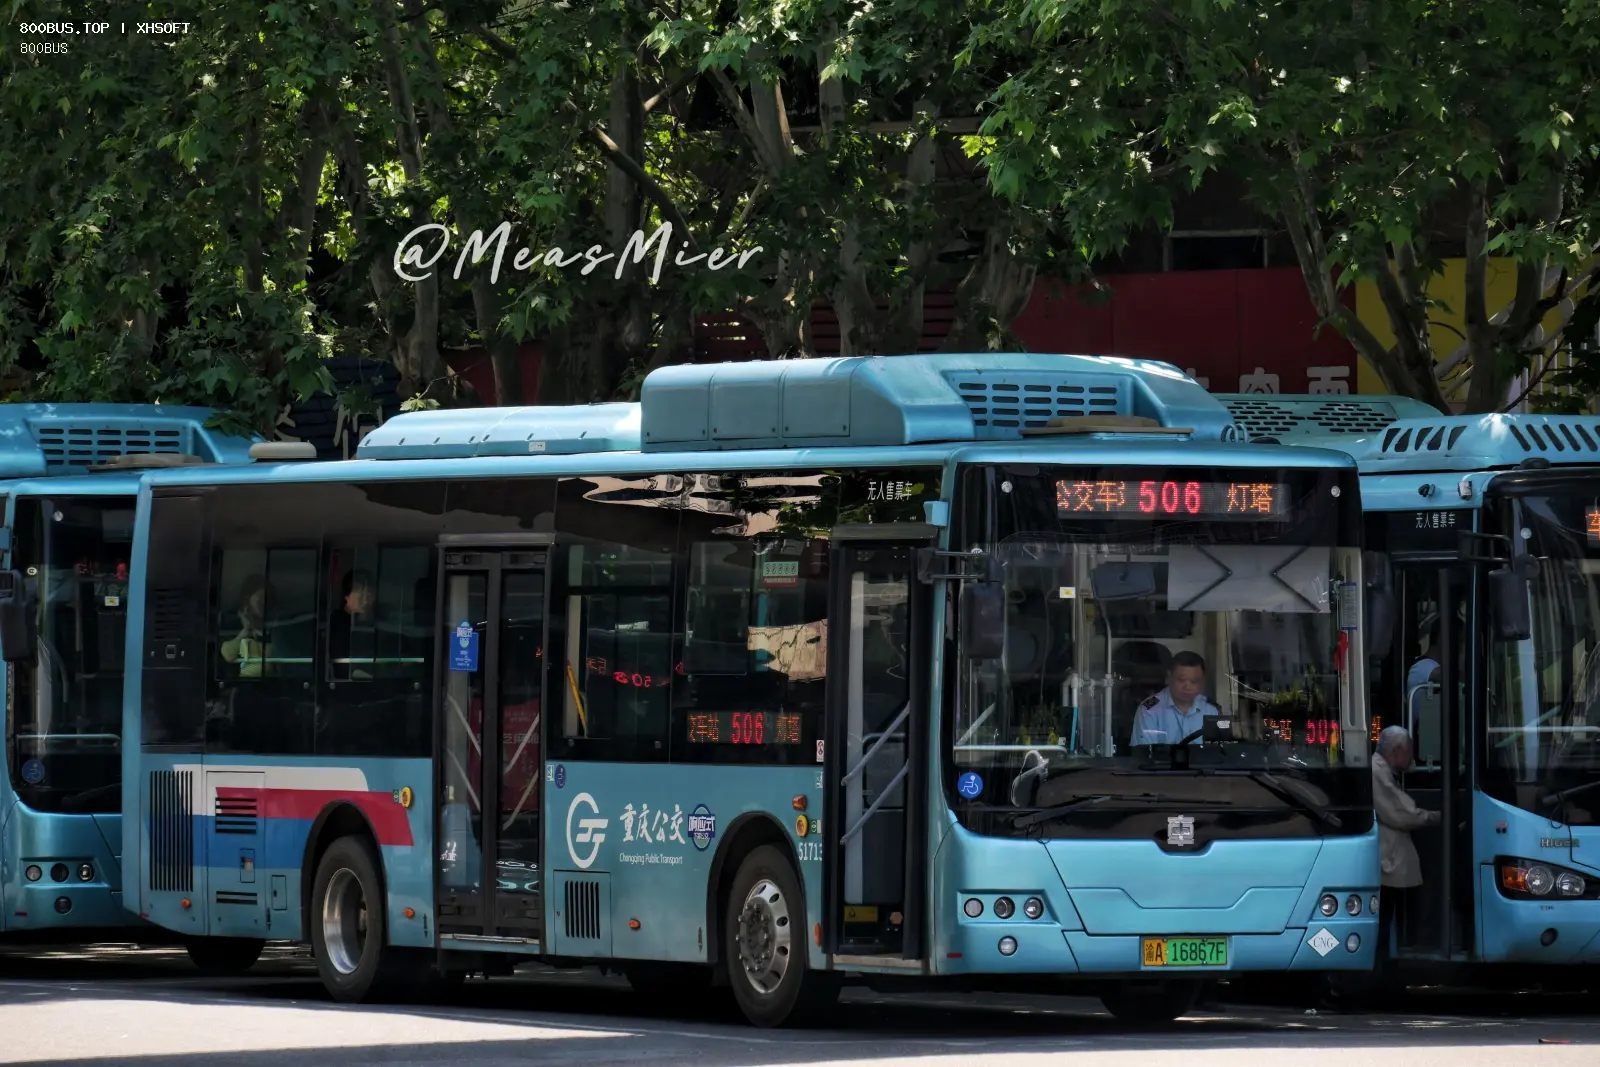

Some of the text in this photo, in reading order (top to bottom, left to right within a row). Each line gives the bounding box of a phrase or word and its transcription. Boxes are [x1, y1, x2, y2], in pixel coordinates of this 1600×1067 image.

[867, 481, 913, 501] 无人售票车
[1140, 481, 1201, 513] 506
[1227, 483, 1273, 513] 灯塔
[1415, 512, 1456, 529] 无人售票车
[731, 712, 764, 744] 506
[619, 803, 686, 845] 重庆公交
[619, 852, 683, 866] Chongqing Public Transport
[1171, 942, 1225, 962] 16867F
[1313, 937, 1334, 948] CNG
